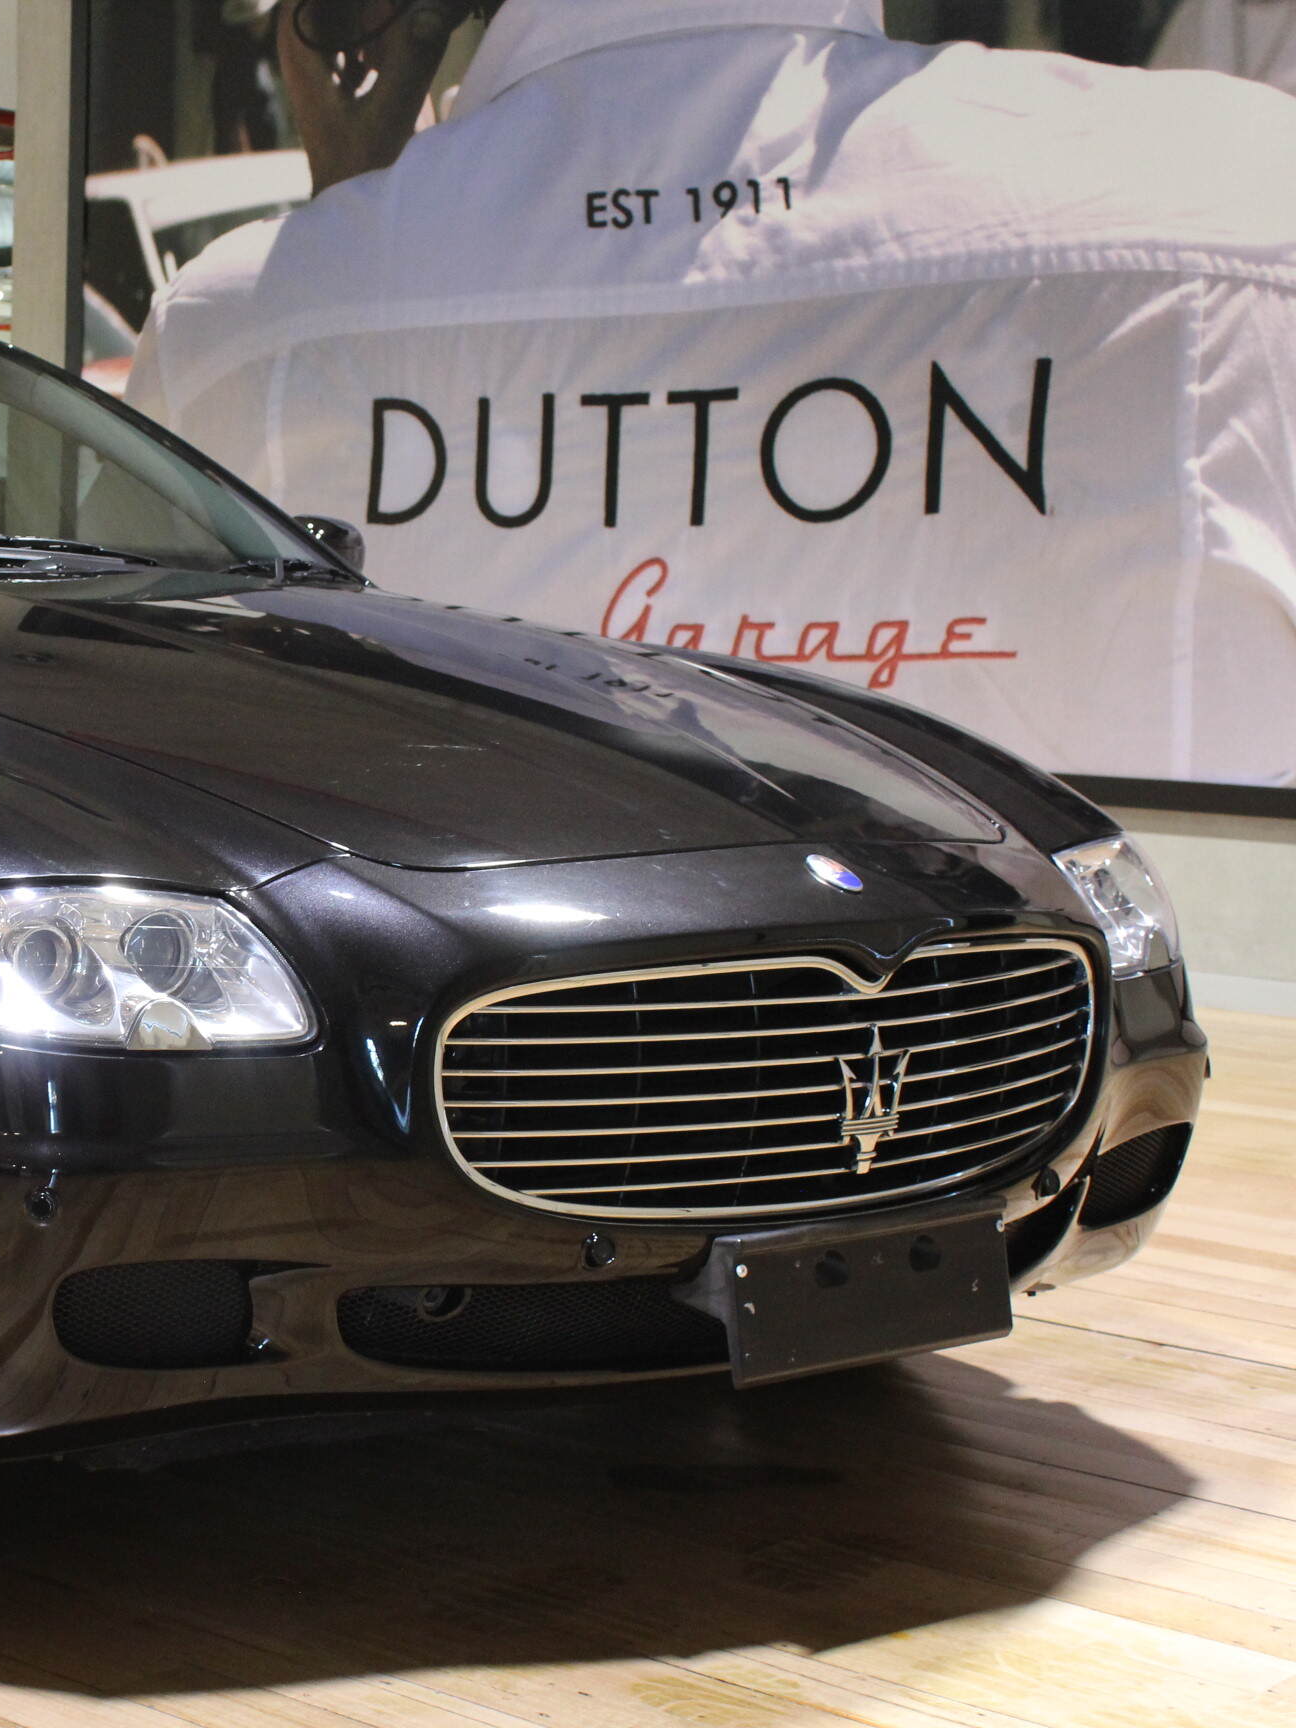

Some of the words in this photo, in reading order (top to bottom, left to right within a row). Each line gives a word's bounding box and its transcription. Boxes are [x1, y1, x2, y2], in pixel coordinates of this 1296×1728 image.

[586, 188, 660, 230] EST
[685, 176, 791, 223] 1911
[366, 357, 1052, 529] DUTTON
[600, 556, 1017, 690] Garage
